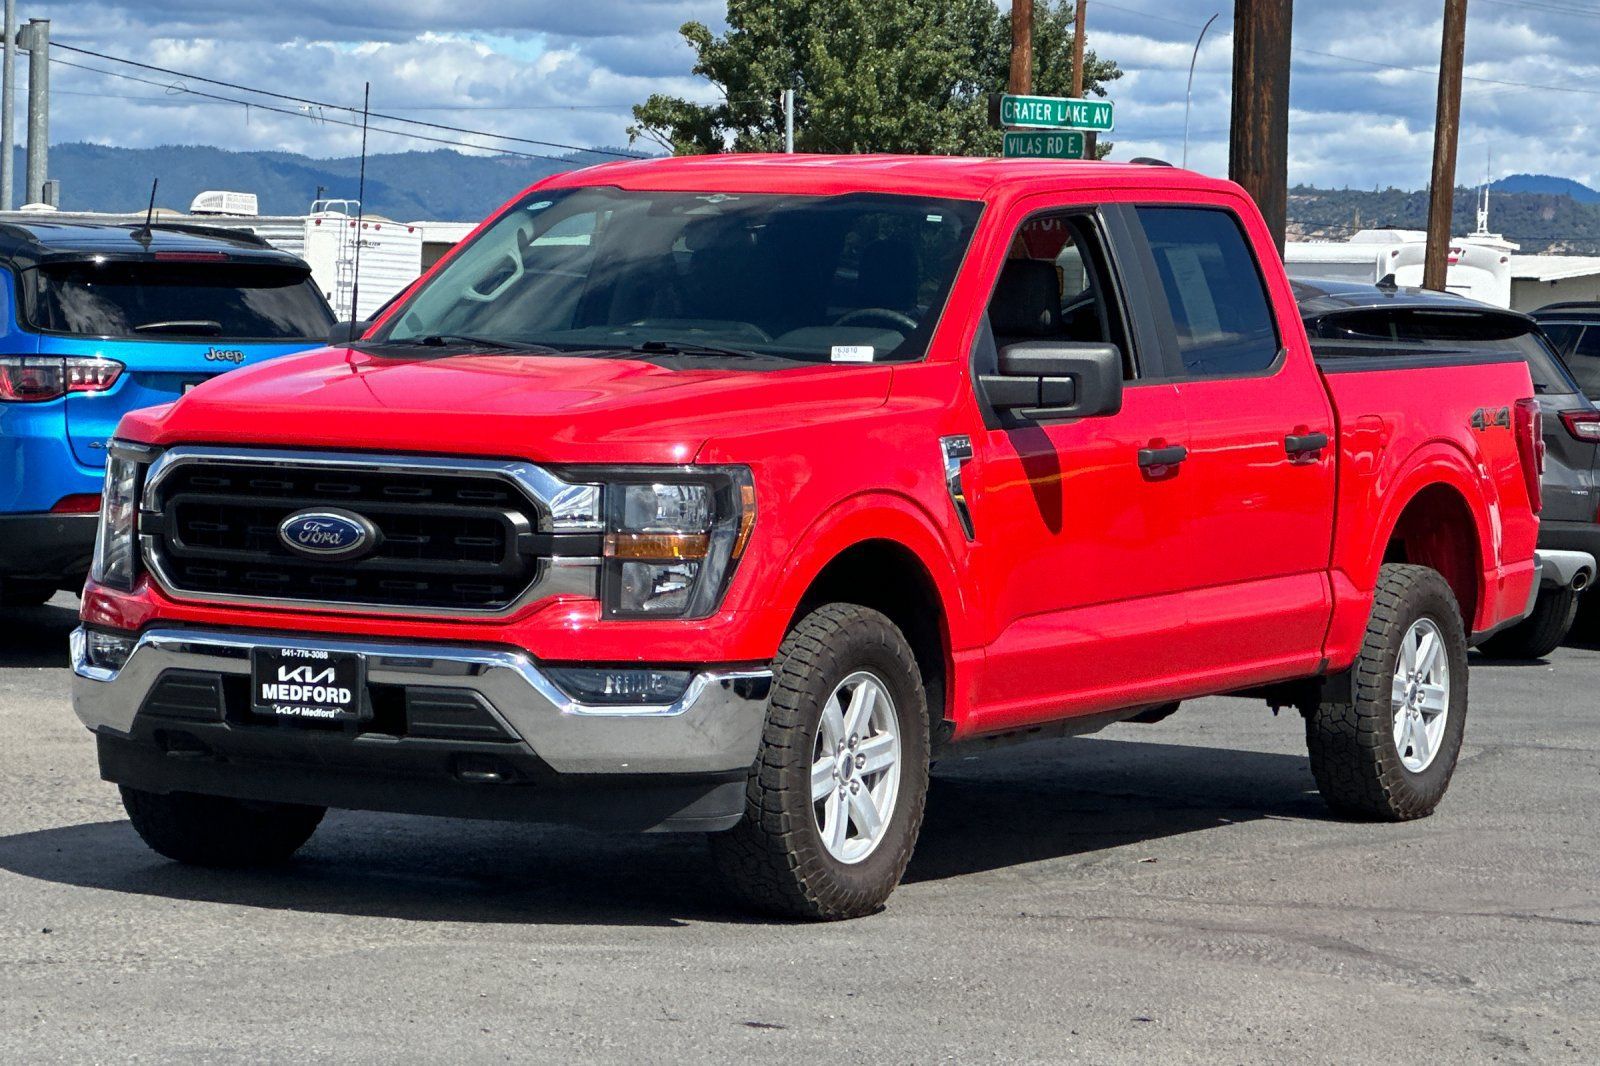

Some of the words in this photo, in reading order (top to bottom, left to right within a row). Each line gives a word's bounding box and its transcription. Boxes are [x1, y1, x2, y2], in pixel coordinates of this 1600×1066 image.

[1004, 102, 1052, 121] CRATER
[1057, 104, 1089, 123] LAKE
[1093, 107, 1109, 124] AV
[1008, 137, 1042, 155] VILAS
[1046, 137, 1064, 155] RD
[1067, 137, 1079, 154] E.
[204, 347, 244, 364] Jeep
[298, 520, 345, 545] Ford
[261, 683, 352, 704] MEDFORD
[301, 706, 335, 718] Medford
